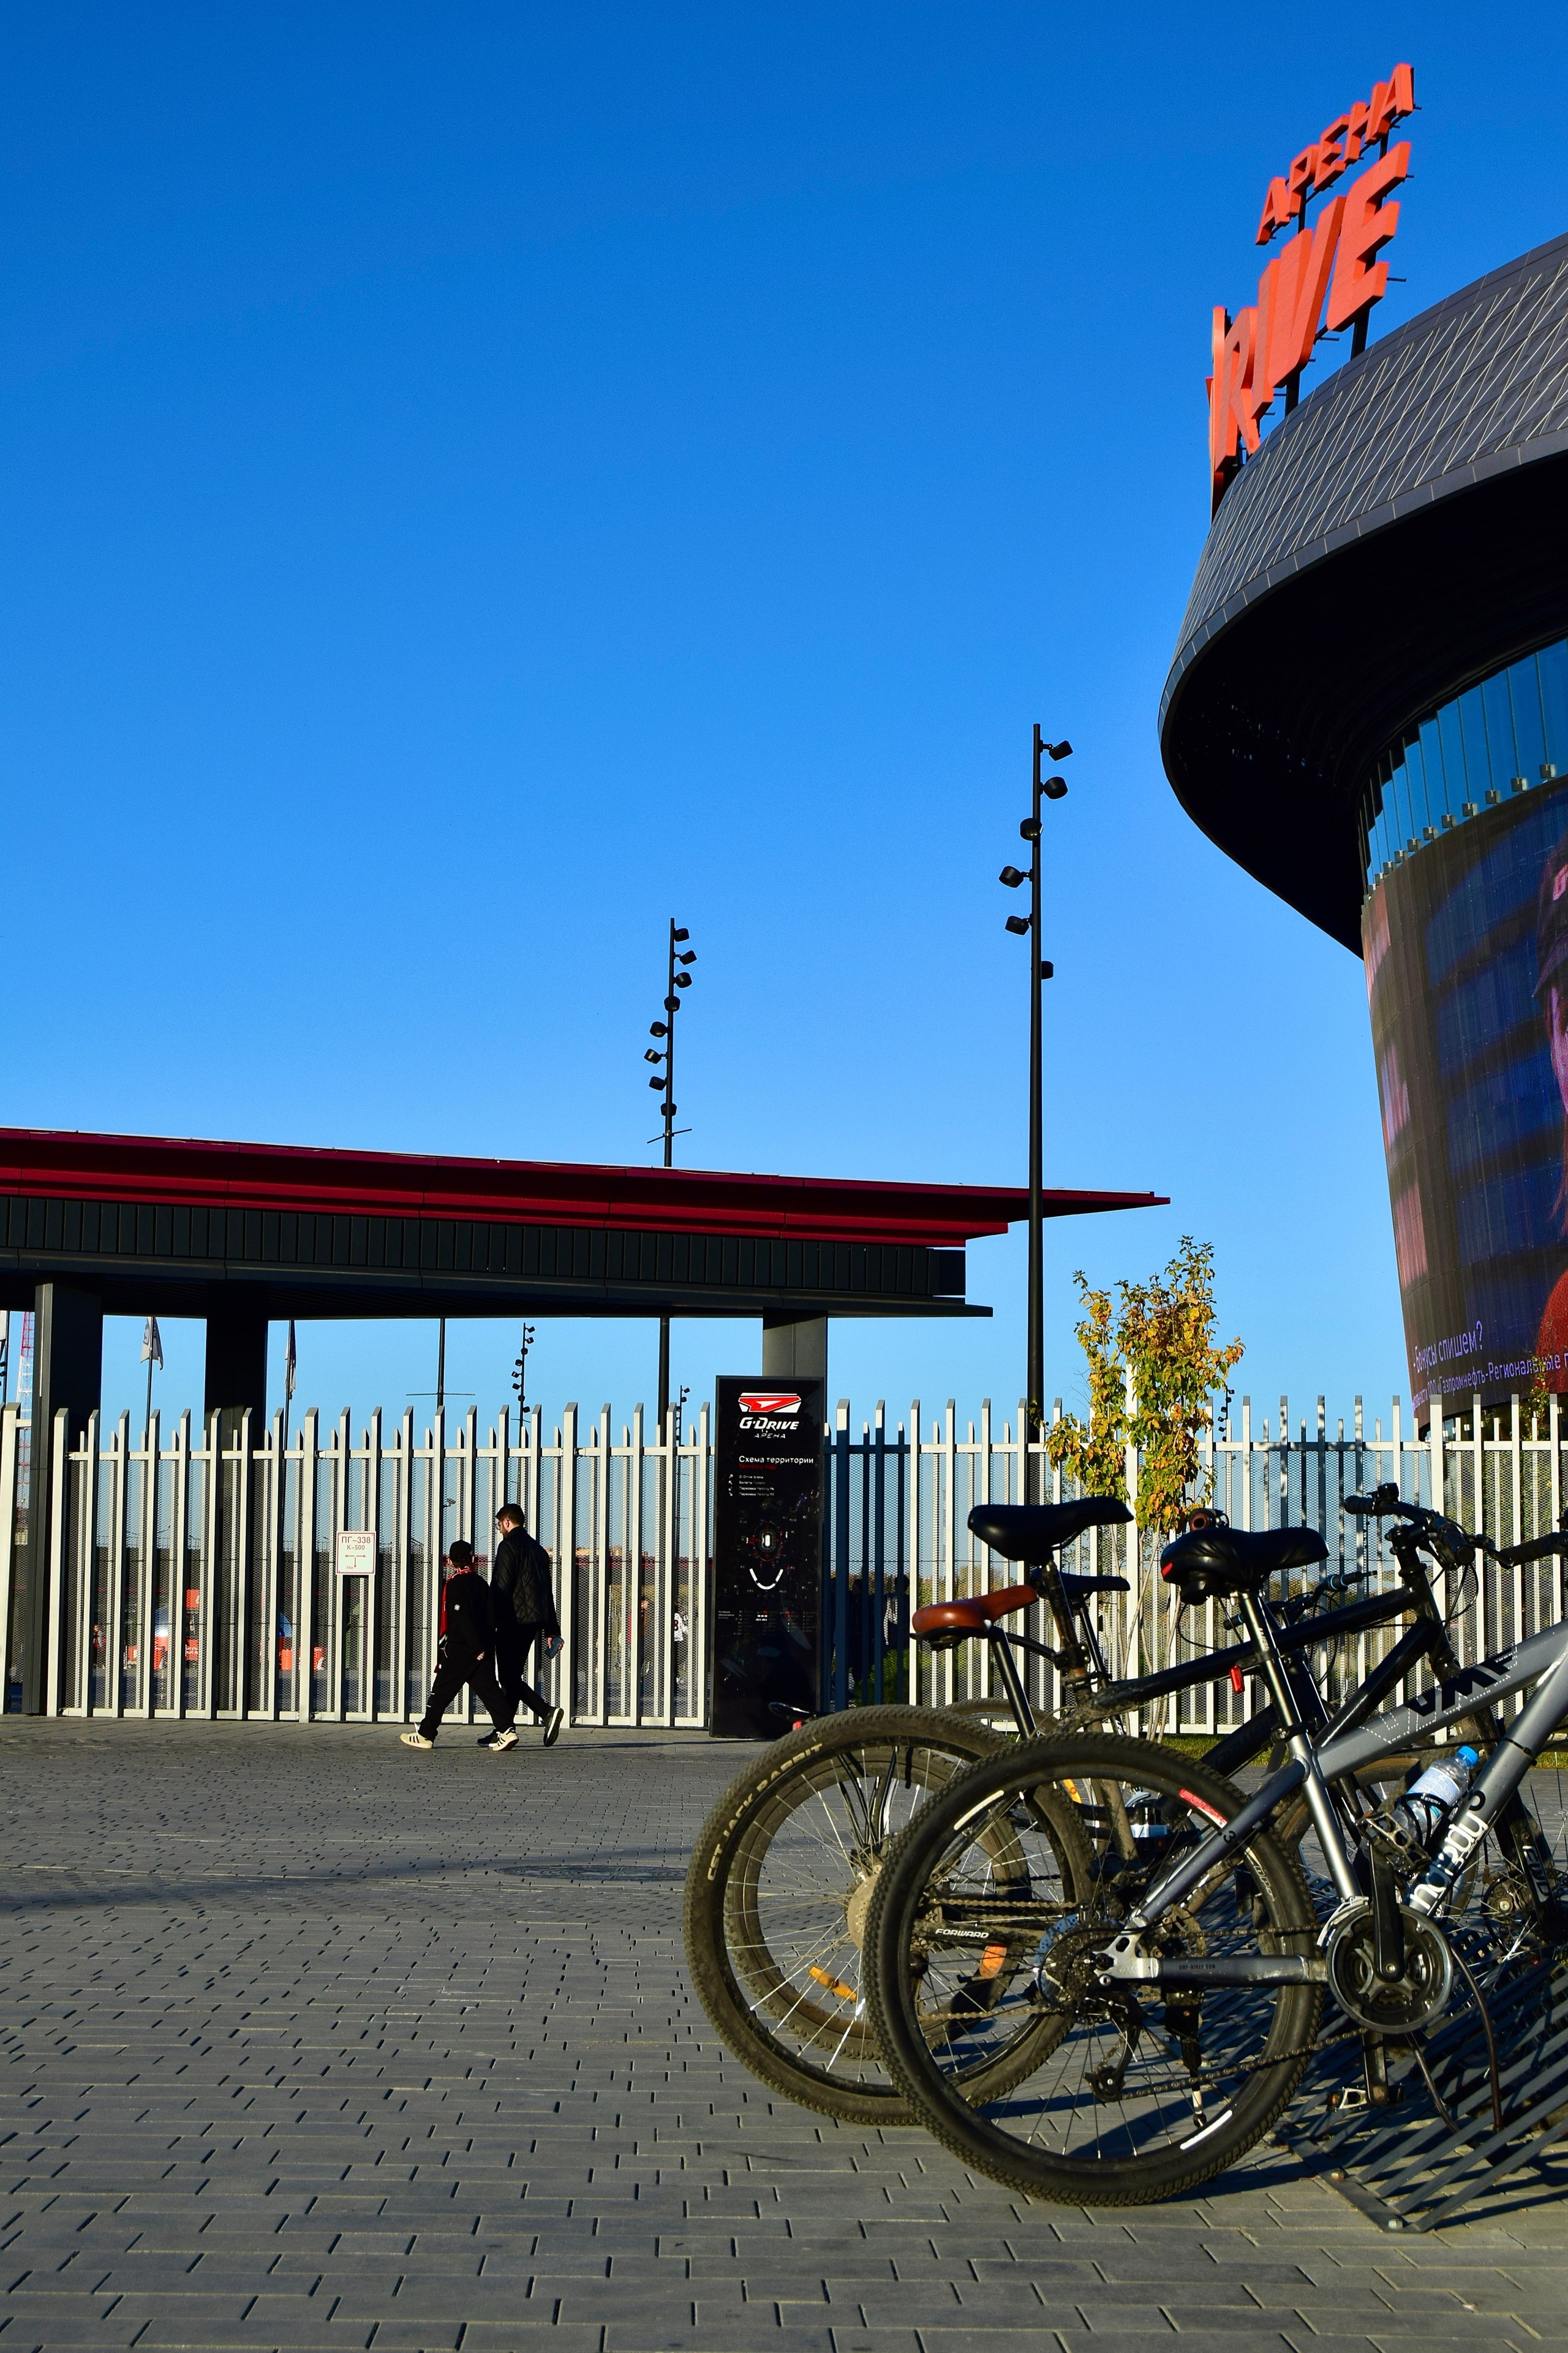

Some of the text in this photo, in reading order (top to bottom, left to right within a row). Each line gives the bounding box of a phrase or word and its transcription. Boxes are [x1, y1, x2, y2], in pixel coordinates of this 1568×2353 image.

[1256, 63, 1414, 245] АРЕНА
[1438, 1320, 1483, 1361] спишем?
[935, 1928, 989, 1939] FORWARD
